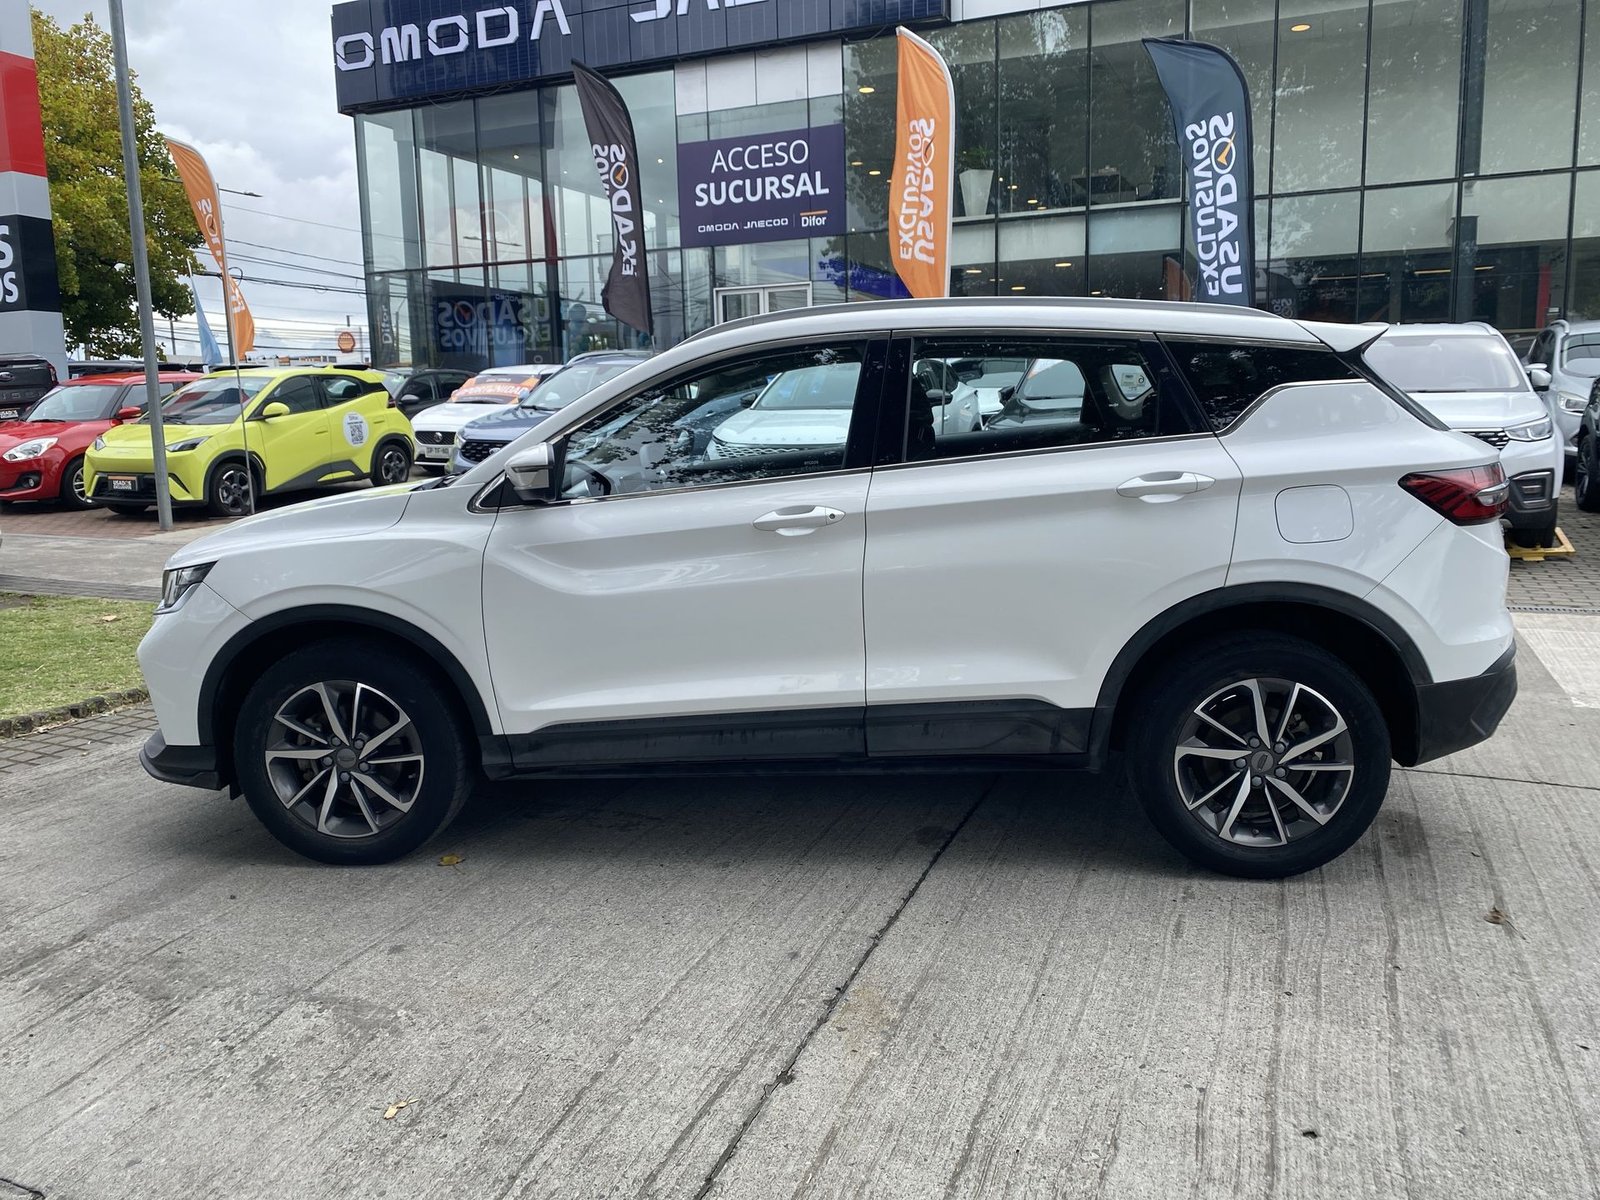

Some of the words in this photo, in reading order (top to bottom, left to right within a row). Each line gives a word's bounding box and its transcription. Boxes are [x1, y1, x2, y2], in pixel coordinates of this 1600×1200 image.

[335, 0, 572, 72] OMODA
[710, 139, 809, 174] ACCESO
[695, 170, 830, 207] SUCURSAL
[697, 222, 740, 233] OMODA
[743, 217, 789, 230] JAECOO
[801, 215, 827, 228] Difor
